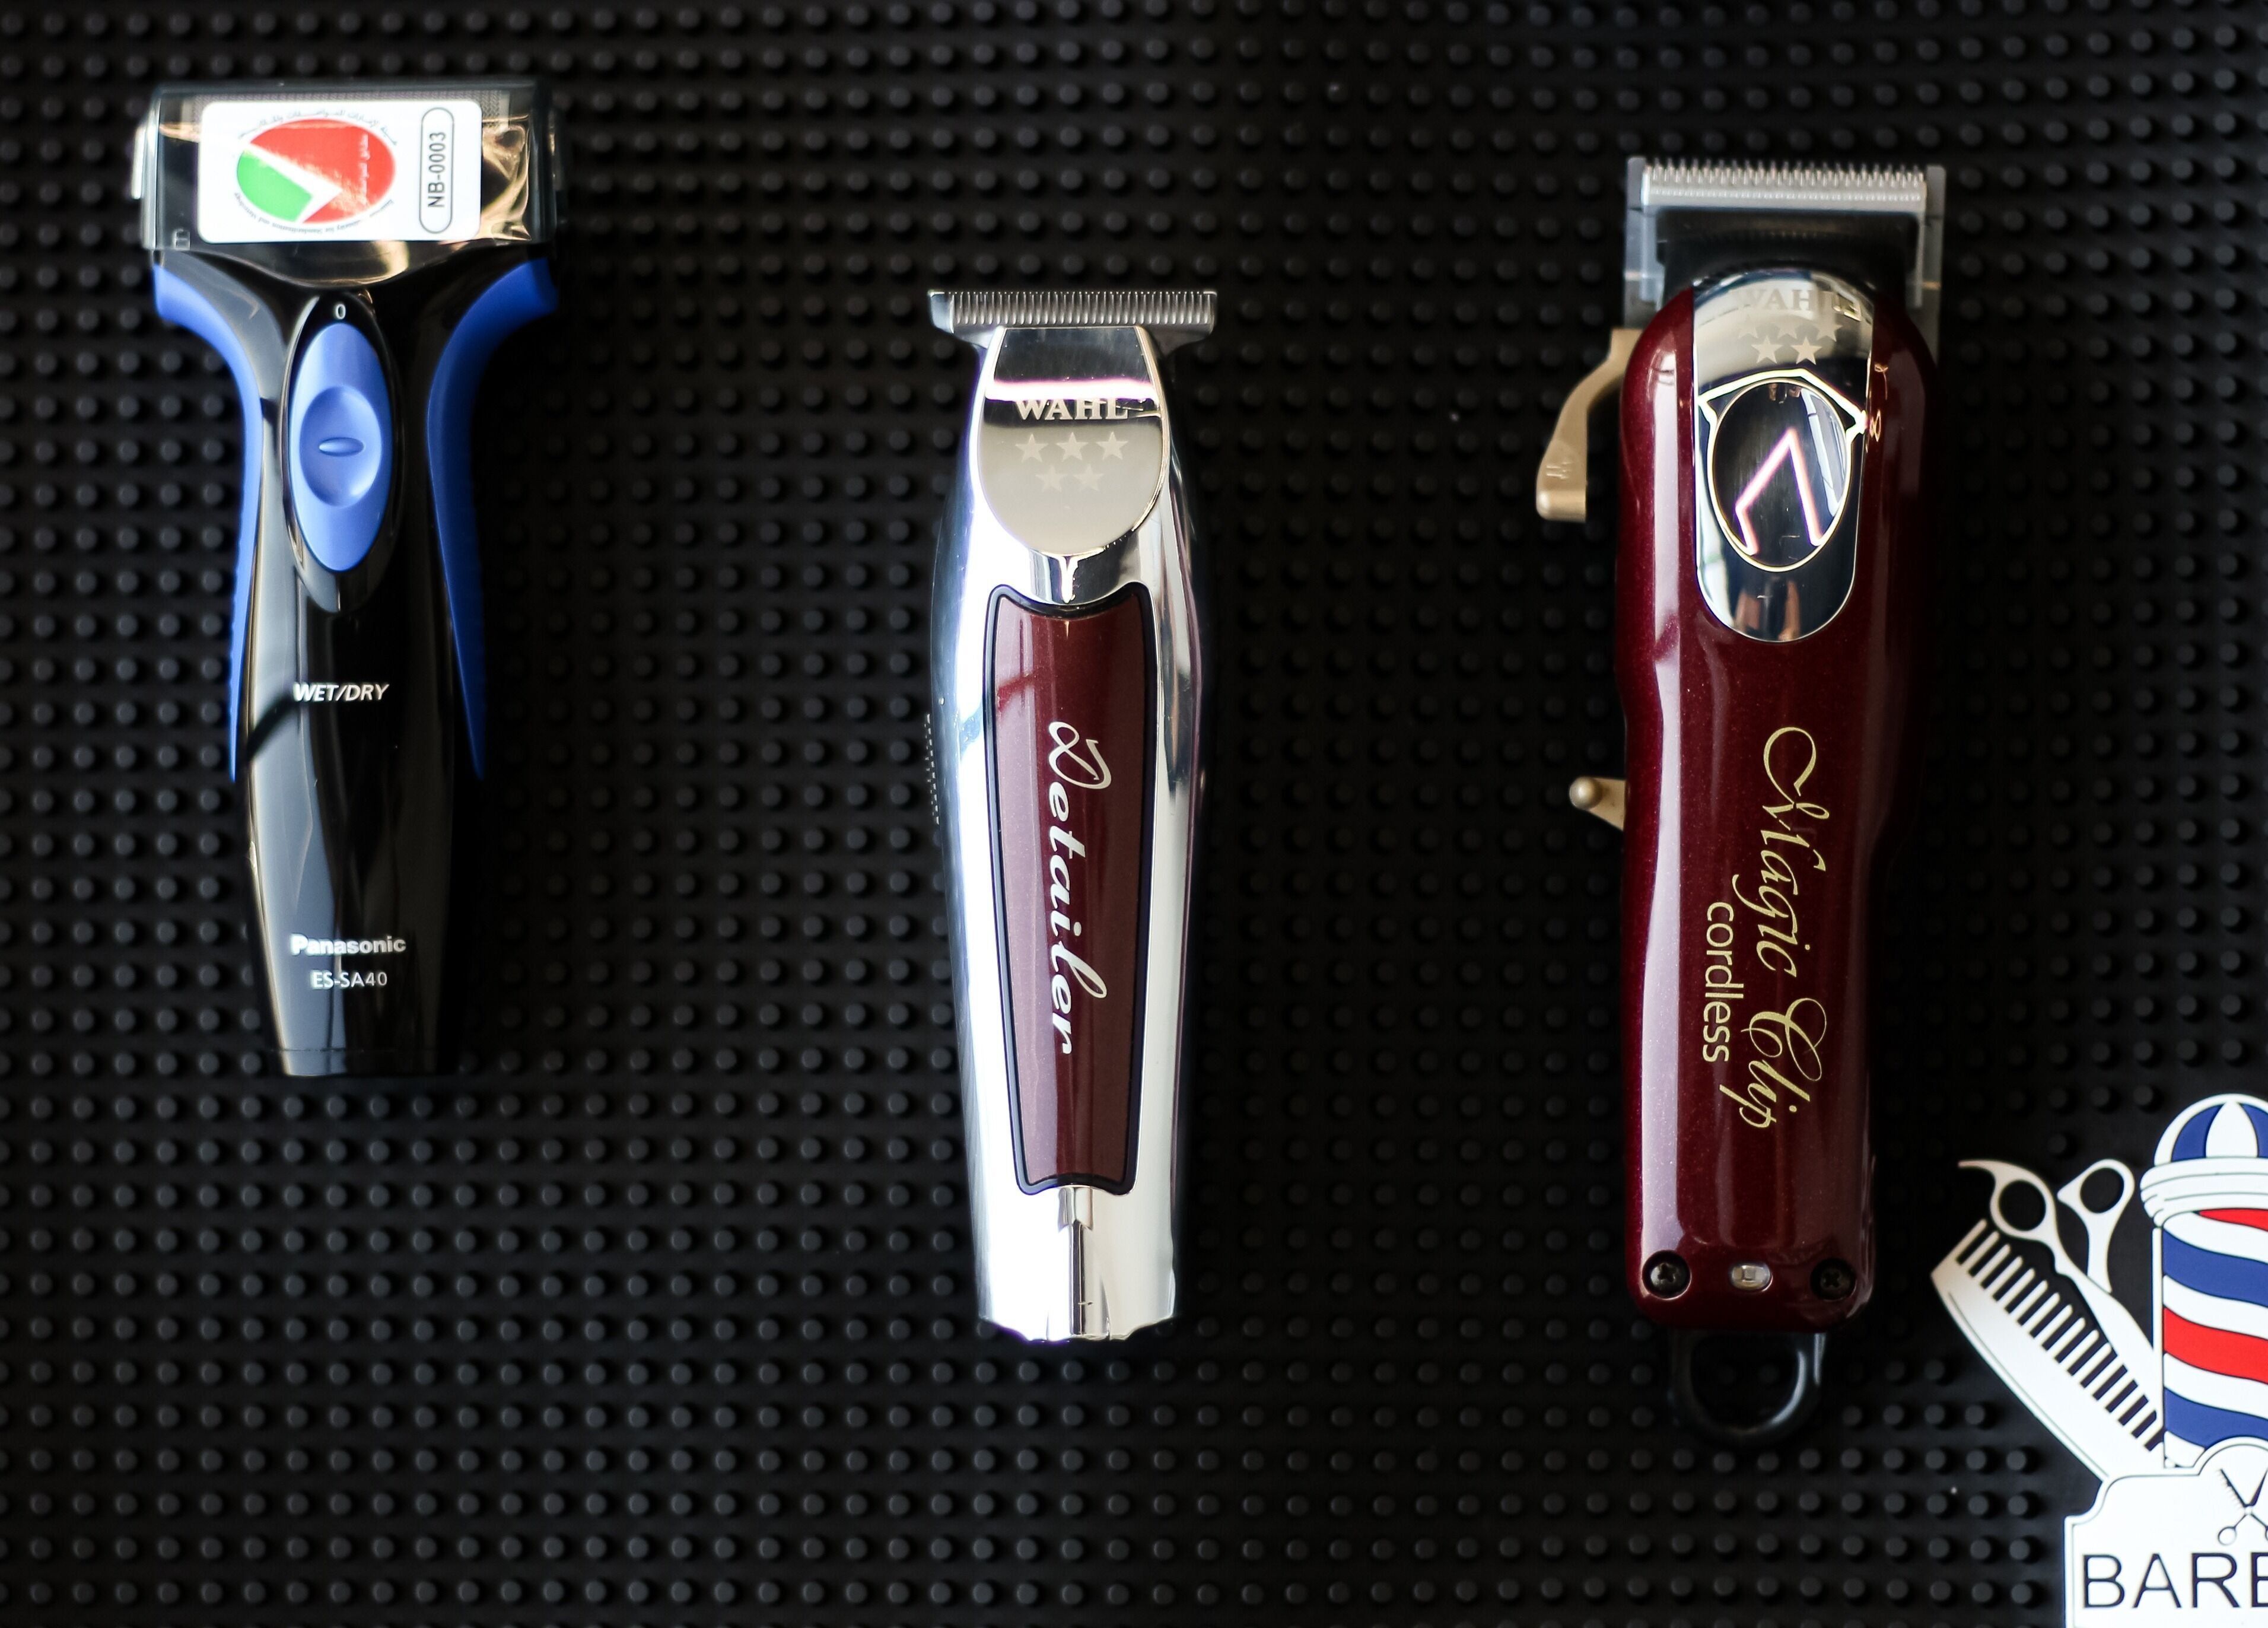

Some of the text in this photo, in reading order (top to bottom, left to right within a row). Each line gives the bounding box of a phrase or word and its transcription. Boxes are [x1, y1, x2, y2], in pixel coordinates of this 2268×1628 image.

[427, 132, 447, 208] NB-0003
[1733, 288, 1836, 311] WAH
[1015, 398, 1128, 421] WAHL
[294, 683, 390, 702] WET/DRY
[1048, 721, 1112, 1054] Detailer
[1719, 726, 1830, 1128] Magic Clip
[290, 934, 407, 956] Panasonic
[311, 971, 388, 990] ES-SA40
[1702, 901, 1744, 1063] cordless
